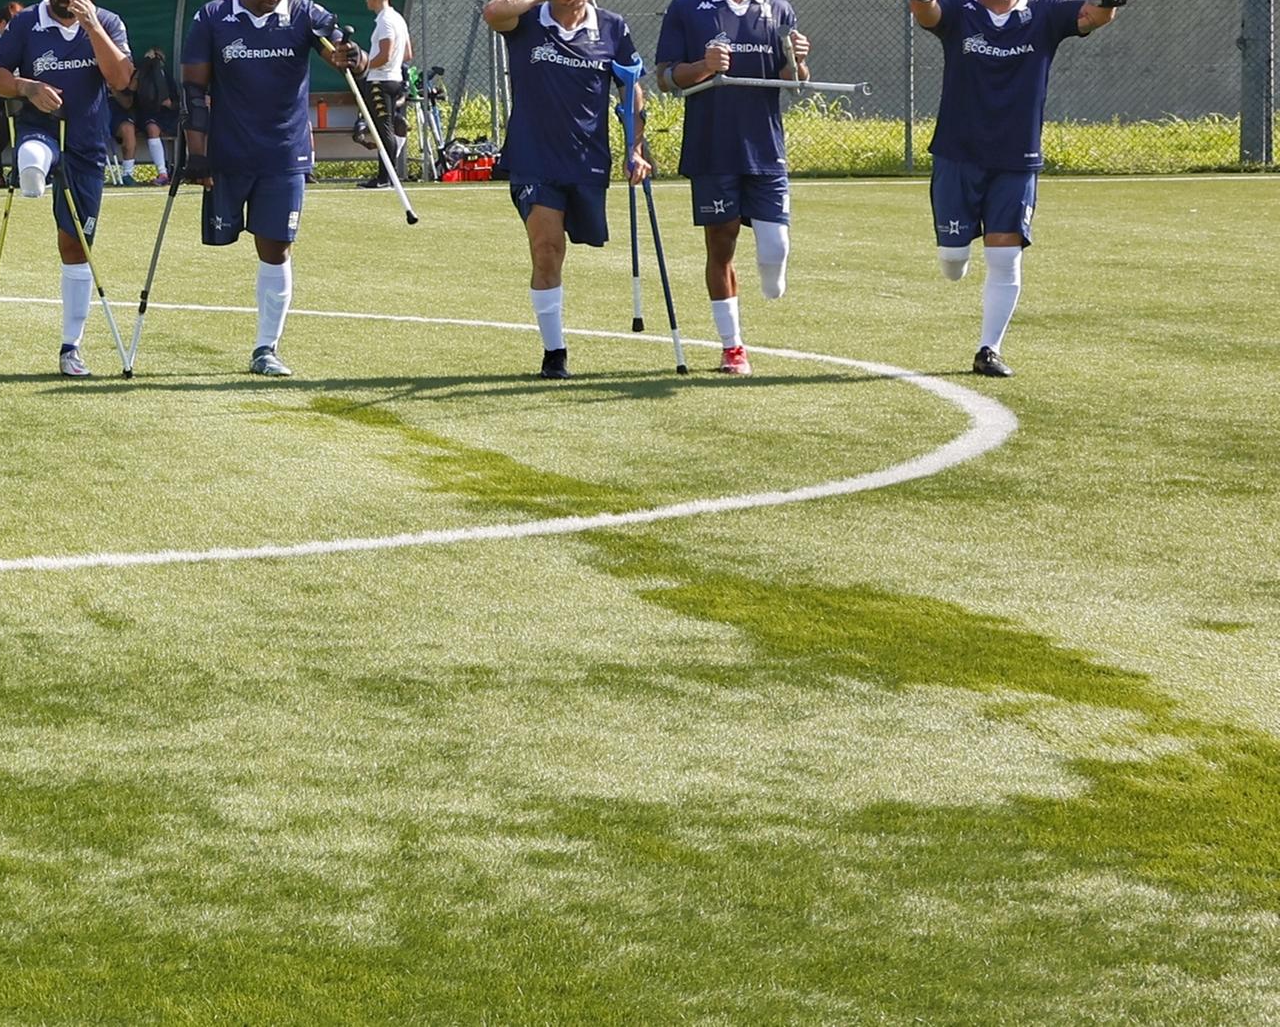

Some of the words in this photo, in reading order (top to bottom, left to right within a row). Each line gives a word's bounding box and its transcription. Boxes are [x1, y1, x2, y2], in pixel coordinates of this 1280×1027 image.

[225, 47, 295, 59] ECOERIDANIA
[730, 42, 774, 54] ERIDANIA
[964, 40, 1035, 57] ECOERIDANIA
[37, 58, 96, 72] ECOERIDAN
[534, 50, 606, 71] ECOERIDANIA
